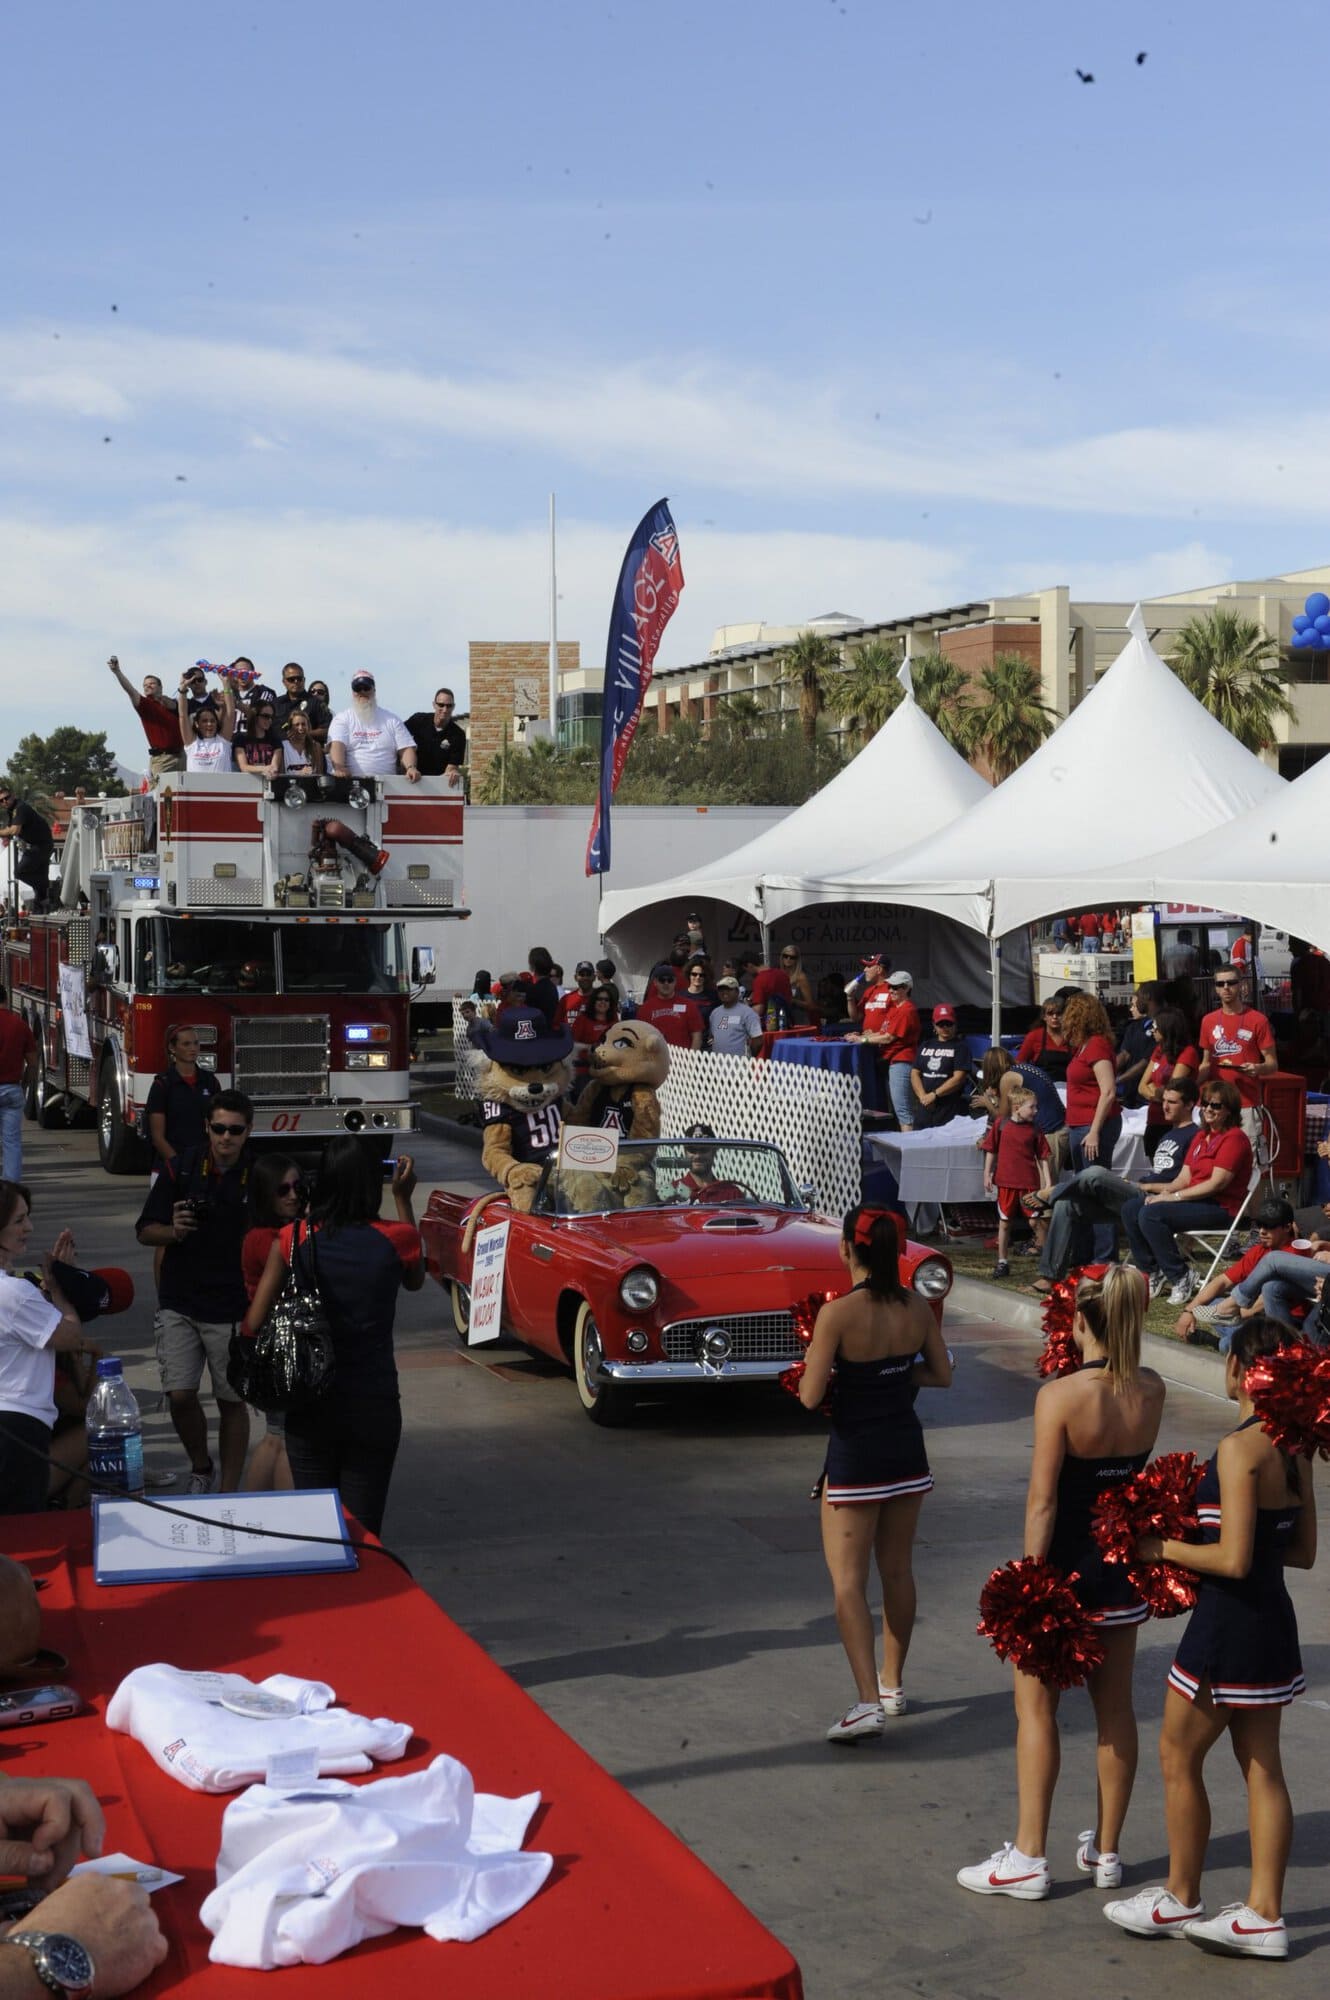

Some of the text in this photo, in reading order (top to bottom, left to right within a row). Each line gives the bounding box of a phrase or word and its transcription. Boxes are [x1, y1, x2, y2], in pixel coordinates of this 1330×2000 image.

[791, 926, 816, 942] OF
[515, 1021, 536, 1039] A
[483, 1102, 501, 1120] 50
[271, 1113, 301, 1132] 01
[527, 1104, 562, 1148] 50
[89, 1460, 123, 1472] SANI
[219, 1509, 237, 1556] Homcoming
[163, 1738, 187, 1762] A
